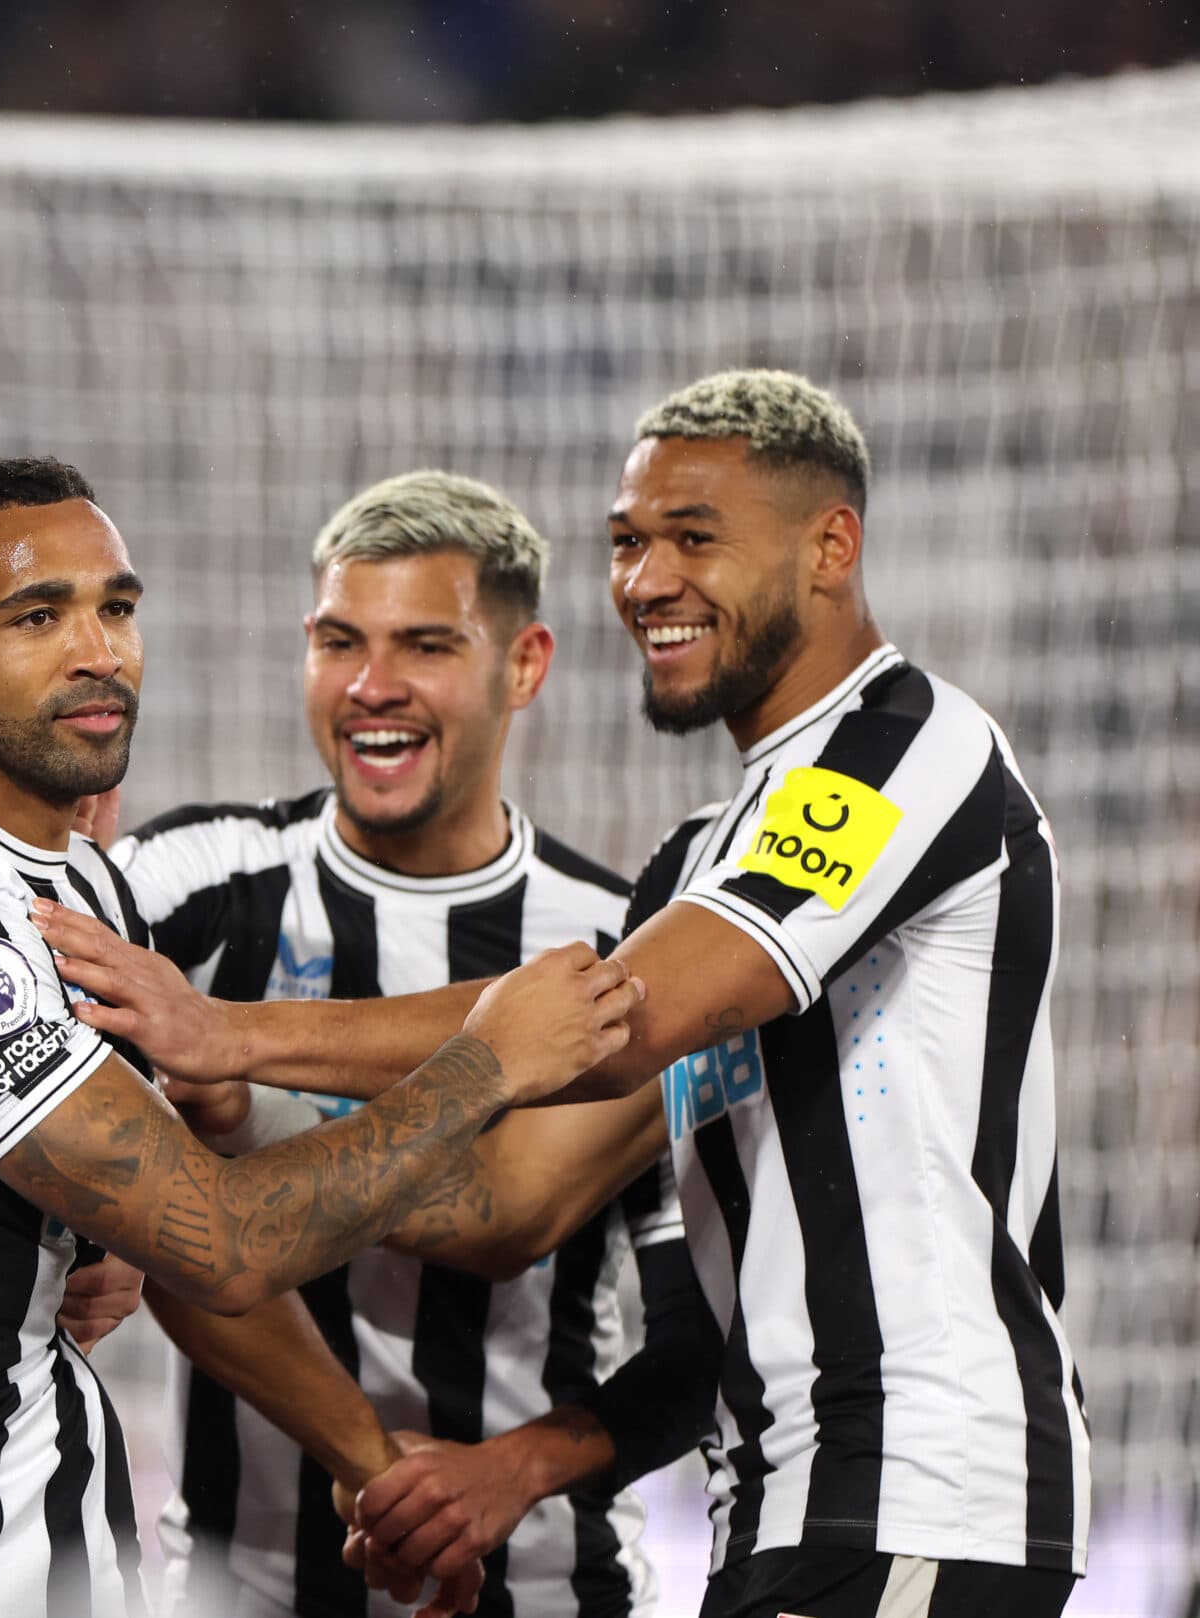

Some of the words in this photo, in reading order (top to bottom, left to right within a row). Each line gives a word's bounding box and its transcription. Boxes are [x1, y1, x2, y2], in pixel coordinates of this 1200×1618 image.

[755, 829, 854, 888] noon
[3, 1021, 57, 1065] room
[12, 1025, 71, 1079] racism
